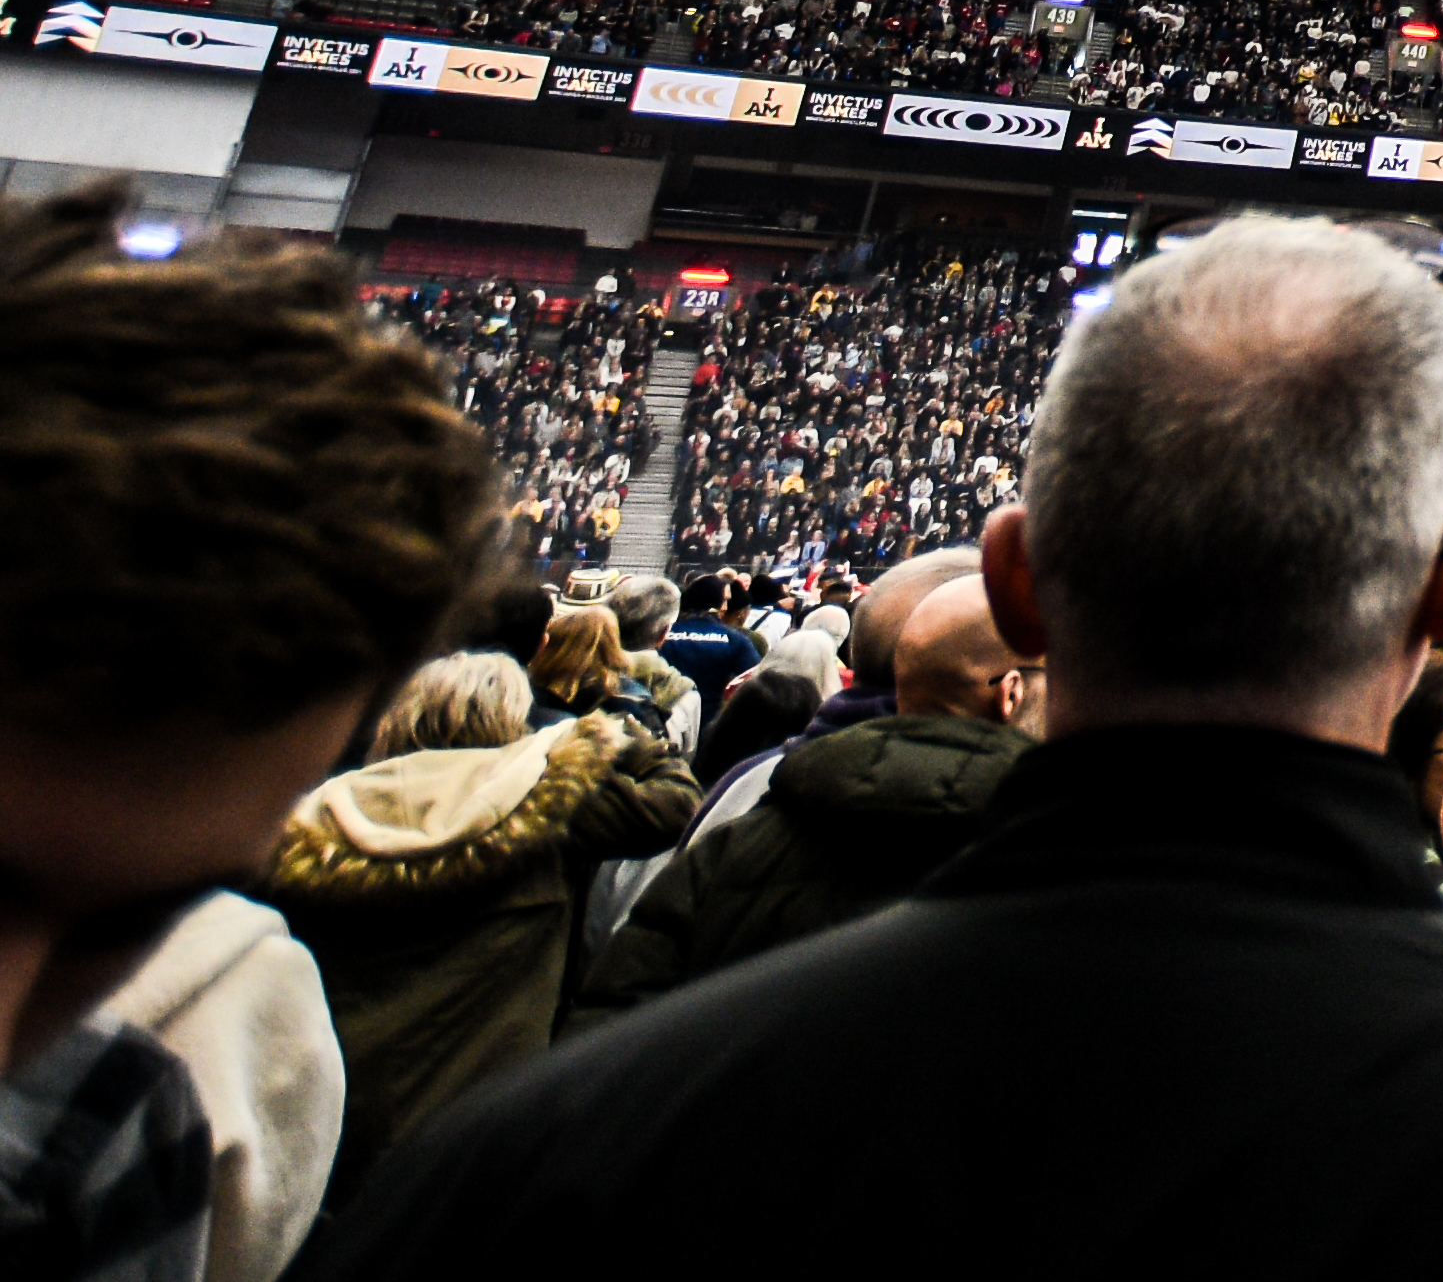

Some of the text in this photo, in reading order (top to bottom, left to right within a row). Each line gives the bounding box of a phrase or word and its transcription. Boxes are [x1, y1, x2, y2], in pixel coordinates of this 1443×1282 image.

[1048, 8, 1075, 23] 439
[284, 36, 369, 55] INVICTUS
[1402, 45, 1427, 58] 440
[284, 43, 351, 66] GAMES
[407, 47, 418, 62] I
[383, 63, 427, 81] AM
[553, 66, 632, 84] INVICTUS
[556, 77, 616, 95] GAMES
[765, 87, 775, 101] I
[810, 92, 883, 109] INVICTUS
[744, 102, 783, 118] AM
[812, 104, 867, 119] GAMES
[1095, 117, 1105, 132] I
[1076, 132, 1113, 149] AM
[1303, 138, 1366, 153] INVICTUS
[1305, 149, 1353, 162] GAMES
[1394, 143, 1402, 157] I
[1378, 157, 1409, 171] AM
